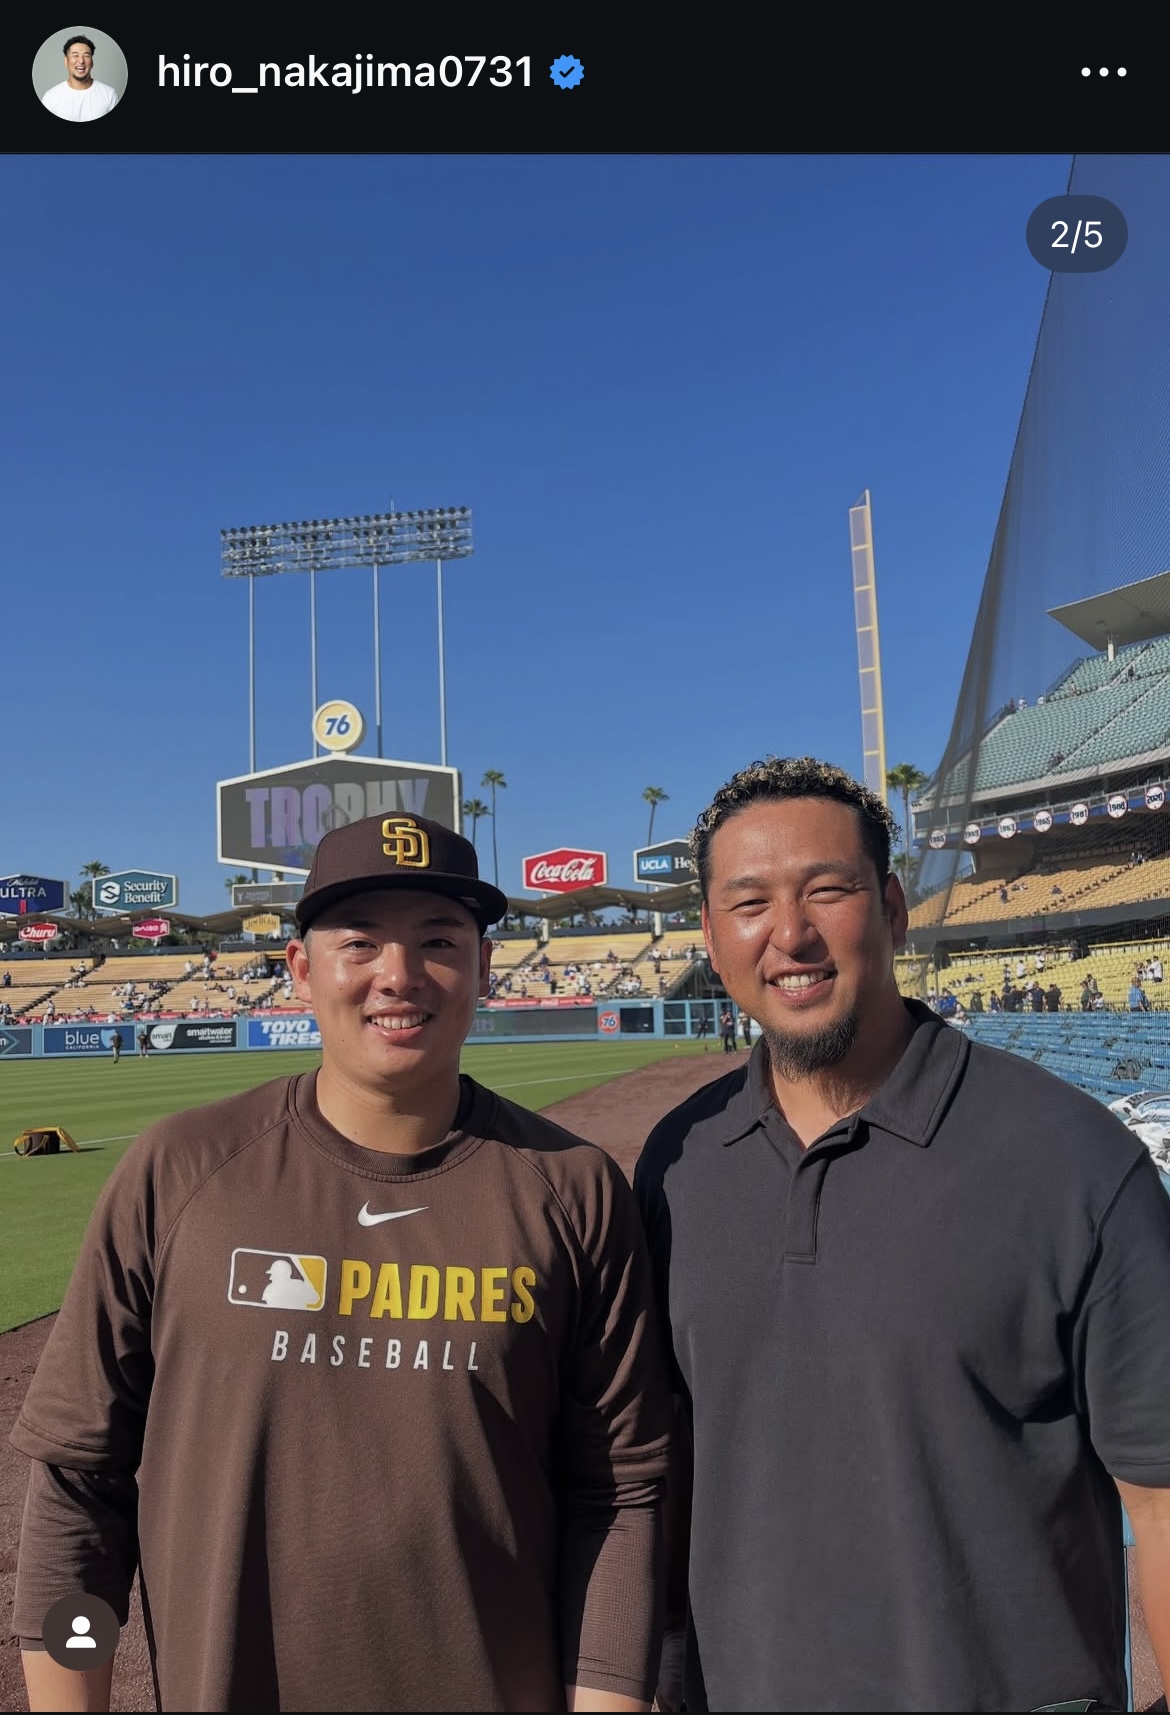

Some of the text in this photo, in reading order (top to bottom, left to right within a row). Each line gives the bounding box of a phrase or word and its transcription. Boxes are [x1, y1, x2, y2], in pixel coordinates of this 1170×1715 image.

[324, 714, 352, 736] 76
[1146, 793, 1163, 804] 2020
[1071, 808, 1088, 819] 1981
[381, 817, 430, 868] SD
[640, 856, 692, 871] UCLA He
[0, 887, 47, 899] ULTRA
[123, 880, 168, 893] Security
[125, 892, 162, 904] Benefit
[20, 926, 56, 939] Churu
[261, 1020, 311, 1034] TOYO
[602, 1015, 616, 1027] 76
[65, 1030, 100, 1045] blue
[151, 1032, 172, 1040] smart
[269, 1032, 322, 1045] TIRES
[338, 1258, 537, 1324] PADRES
[271, 1330, 479, 1371] BASEBALL
